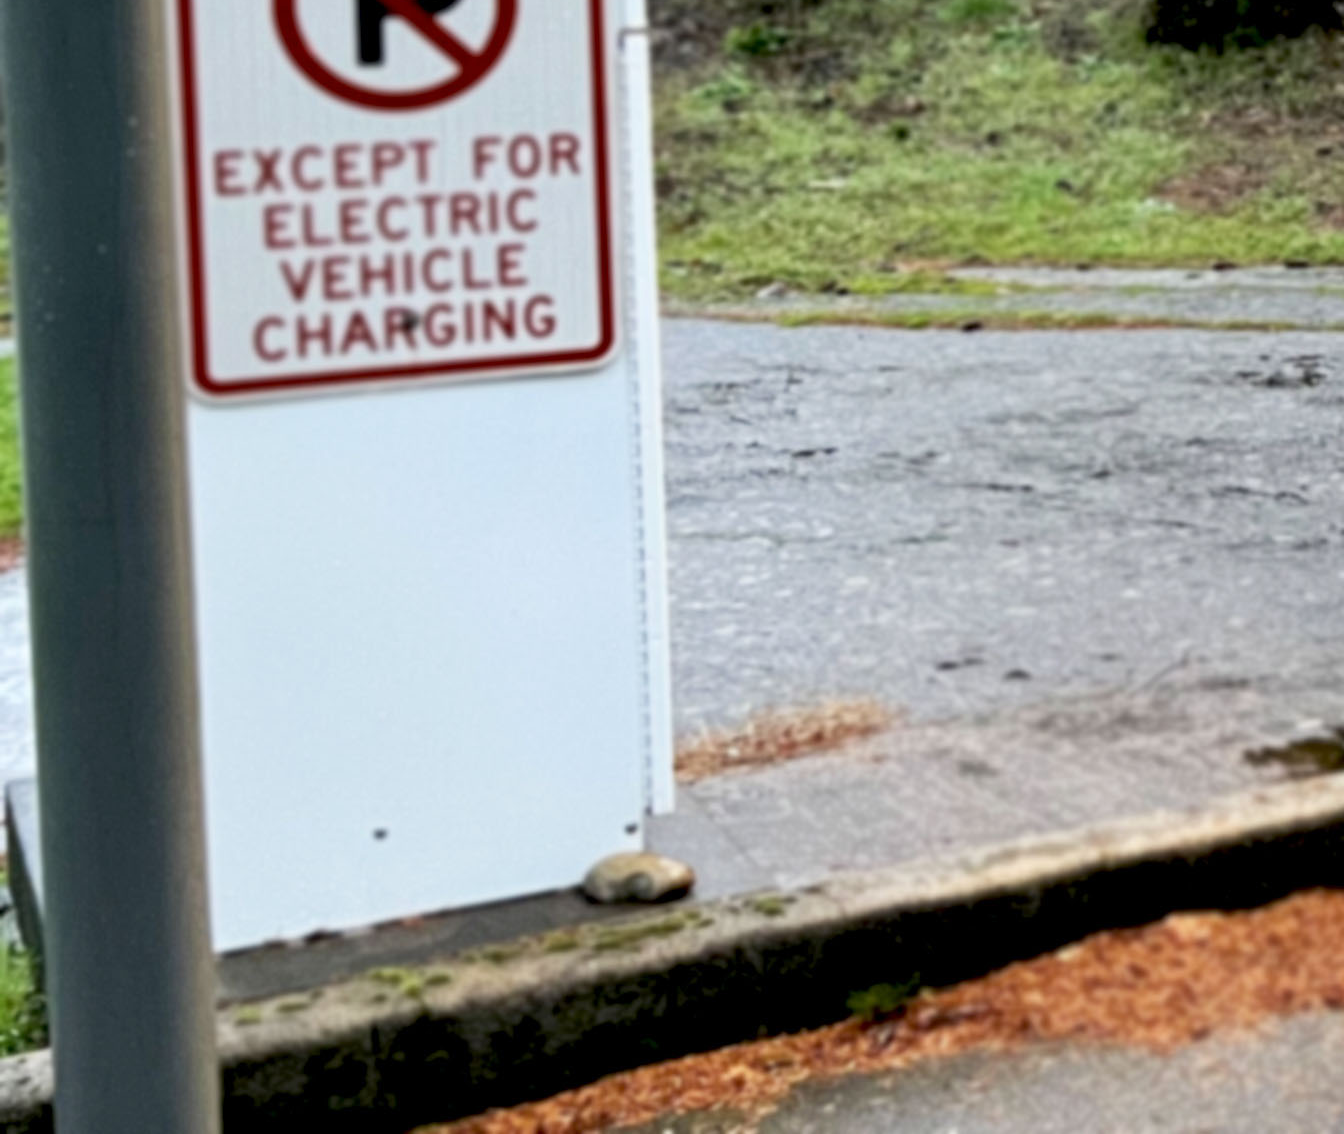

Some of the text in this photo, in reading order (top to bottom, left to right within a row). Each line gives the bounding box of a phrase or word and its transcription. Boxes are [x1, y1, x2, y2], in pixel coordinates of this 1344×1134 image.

[213, 132, 582, 197] EXCEPT FOR
[262, 189, 538, 250] ELECTRIC
[280, 242, 529, 303] VEHICLE
[252, 294, 558, 362] CHARGING
